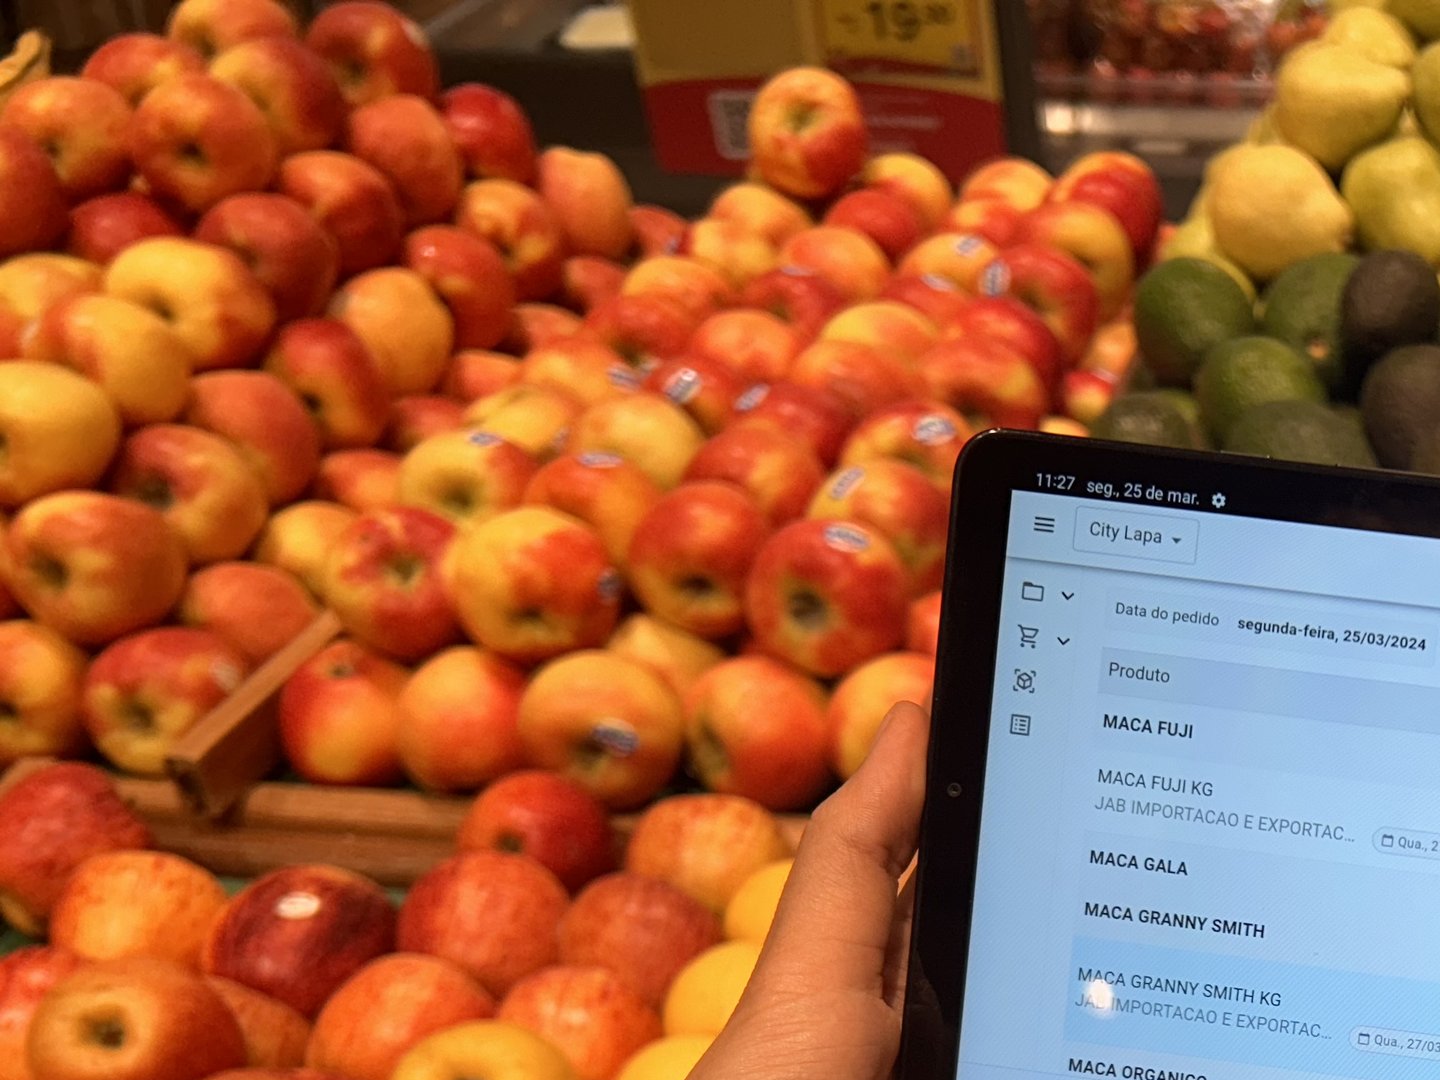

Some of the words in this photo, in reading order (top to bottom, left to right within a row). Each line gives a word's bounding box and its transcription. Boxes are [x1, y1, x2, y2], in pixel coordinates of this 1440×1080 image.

[1036, 473, 1075, 490] 11:27
[1086, 481, 1120, 498] seg.,
[1124, 483, 1142, 498] 25
[1146, 486, 1163, 501] de
[1168, 490, 1199, 505] mar.
[1090, 522, 1120, 542] City
[1125, 525, 1162, 546] Lapa
[1115, 602, 1147, 618] Data
[1151, 606, 1169, 620] do
[1172, 610, 1220, 626] pedido
[1237, 618, 1339, 643] segunda-feira,
[1343, 630, 1426, 651] 25/03/2024
[1109, 662, 1170, 683] Produto
[1103, 714, 1153, 734] MACA
[1158, 721, 1193, 739] FUJI
[1097, 766, 1147, 789] MACA
[1151, 776, 1187, 794] FUJI
[1191, 781, 1214, 797] KG
[1095, 796, 1126, 813] JAB
[1131, 800, 1240, 829] IMPORTACAO
[1244, 815, 1254, 830] E
[1089, 849, 1139, 870] MACA
[1144, 857, 1189, 876] GALA
[1084, 903, 1134, 923] MACA
[1138, 909, 1209, 932] GRANNY
[1211, 919, 1266, 939] SMITH
[1078, 967, 1127, 987] MACA
[1130, 974, 1201, 996] GRANNY
[1203, 984, 1255, 1004] SMITH
[1259, 991, 1282, 1008] KG
[1111, 997, 1218, 1025] IMPORTACAO
[1222, 1011, 1233, 1026] E
[1068, 1058, 1117, 1078] MACA
